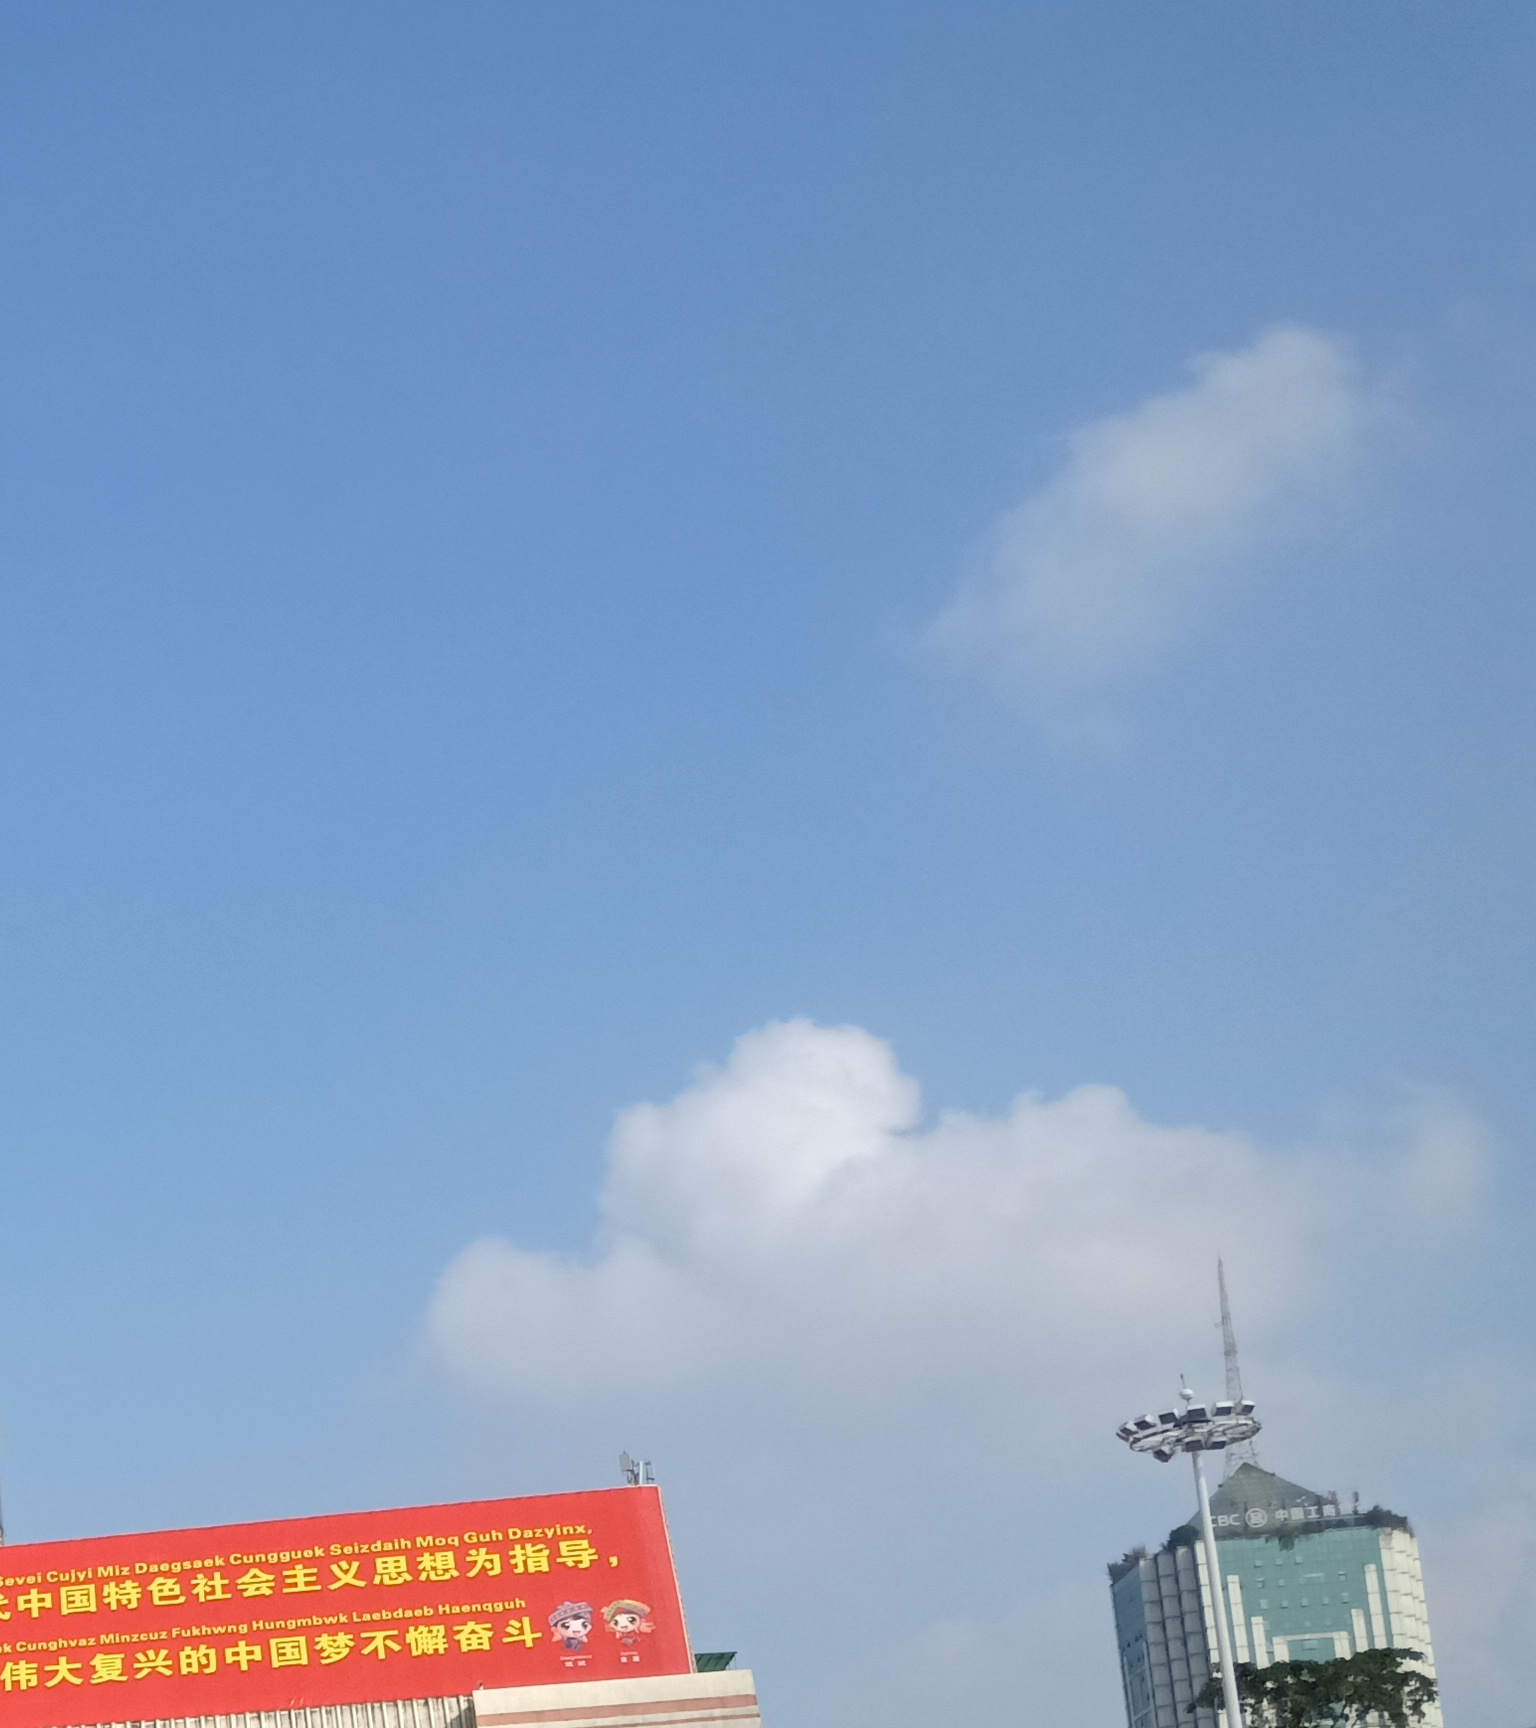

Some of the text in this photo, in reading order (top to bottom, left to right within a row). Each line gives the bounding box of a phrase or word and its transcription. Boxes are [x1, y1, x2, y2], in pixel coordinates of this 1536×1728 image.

[46, 1567, 93, 1583] Cujyi
[97, 1564, 130, 1578] Miz
[135, 1556, 225, 1574] Daegsaek
[229, 1546, 325, 1566] Cungguek
[329, 1538, 411, 1556] Seizdaih
[416, 1534, 460, 1549] Moq
[463, 1530, 503, 1544] Guh
[508, 1524, 592, 1540] Dazyinx,
[16, 1637, 97, 1653] Cunghvaz
[100, 1630, 168, 1645] Minzcuz
[171, 1622, 249, 1639] Fukhwng
[252, 1613, 348, 1632] Hungmbwk
[352, 1605, 434, 1622] Laebdaeb
[438, 1598, 526, 1615] Haenqguh
